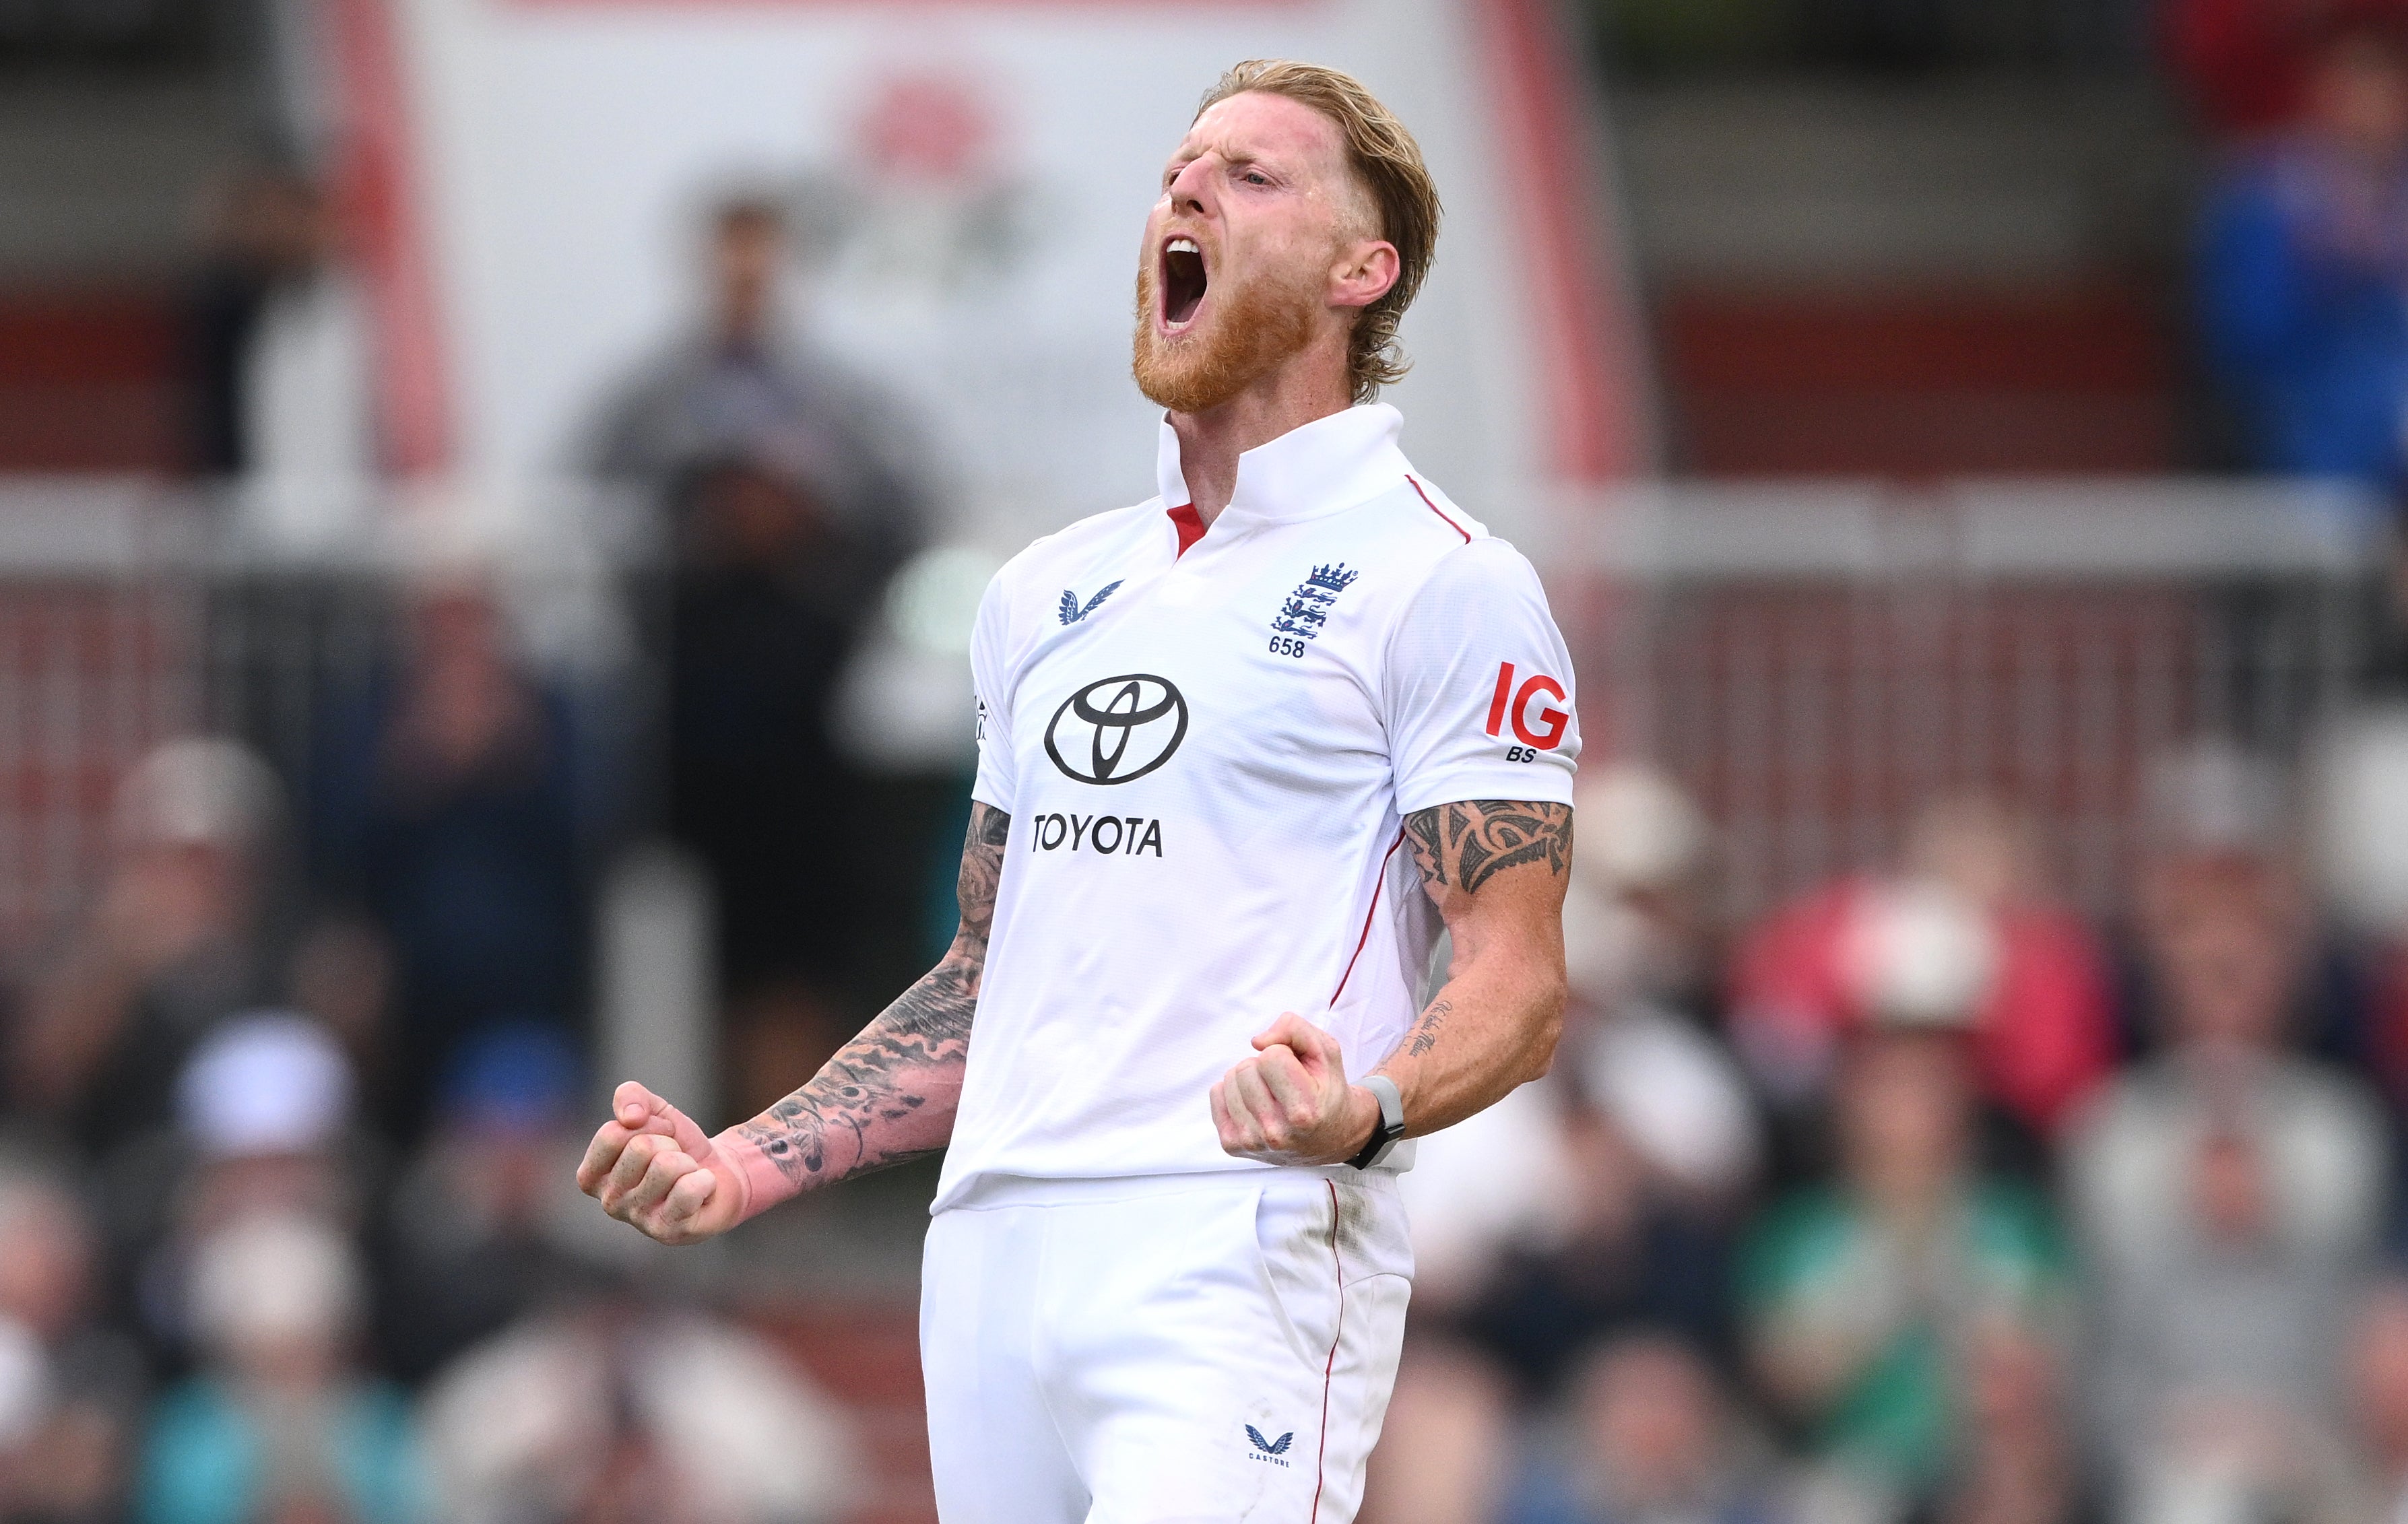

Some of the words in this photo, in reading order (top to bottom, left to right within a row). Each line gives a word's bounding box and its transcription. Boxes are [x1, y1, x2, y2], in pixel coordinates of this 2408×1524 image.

[1269, 635, 1305, 659] 658
[1485, 661, 1569, 750] IG
[1505, 746, 1537, 764] BS
[1033, 813, 1163, 858] TOYOTA
[1248, 1453, 1290, 1468] CASTORE
